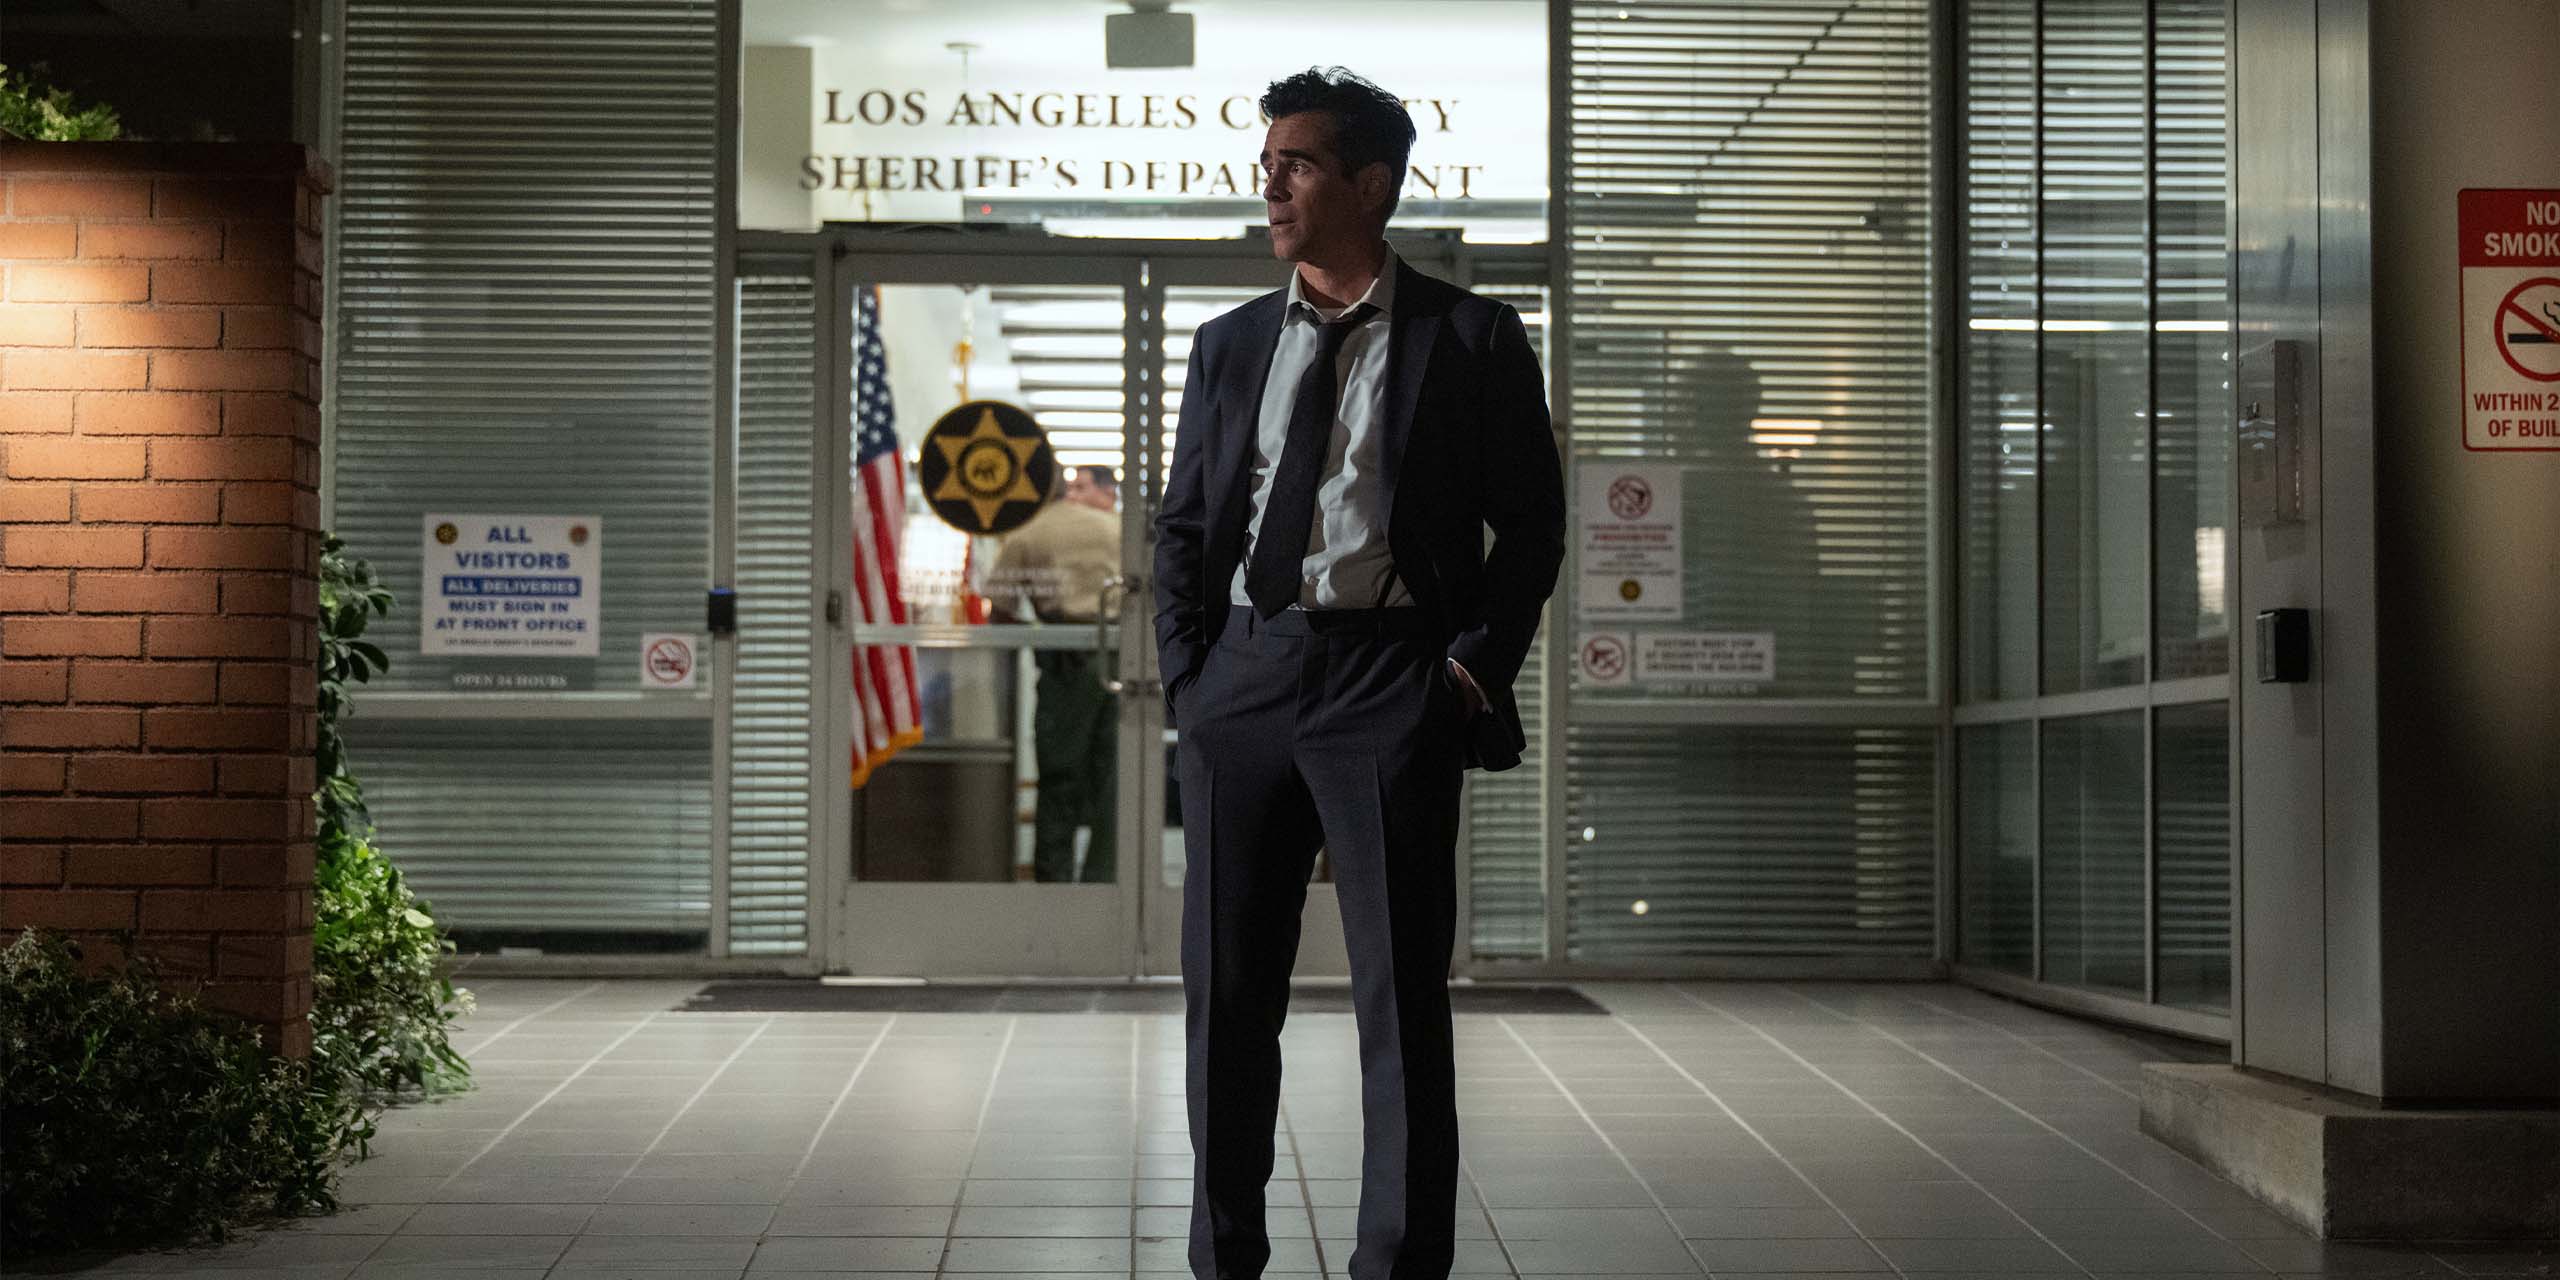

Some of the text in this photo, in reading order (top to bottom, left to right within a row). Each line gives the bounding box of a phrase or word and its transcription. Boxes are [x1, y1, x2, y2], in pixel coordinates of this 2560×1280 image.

[824, 89, 927, 126] LOS
[948, 91, 1199, 132] ANGELES
[799, 153, 1080, 193] SHERIFF'S
[2526, 201, 2560, 225] NO
[2483, 231, 2560, 257] SMOK
[2474, 393, 2544, 412] WITHIN
[2488, 419, 2513, 437] OF
[487, 526, 532, 543] ALL
[455, 552, 571, 570] VISITORS
[447, 580, 577, 594] ALL DELIVERIES
[449, 602, 569, 612] MUST SIGN IN
[436, 619, 587, 632] AT FRONT OFFICE
[453, 672, 494, 687] OPEN
[516, 673, 569, 688] HOURS
